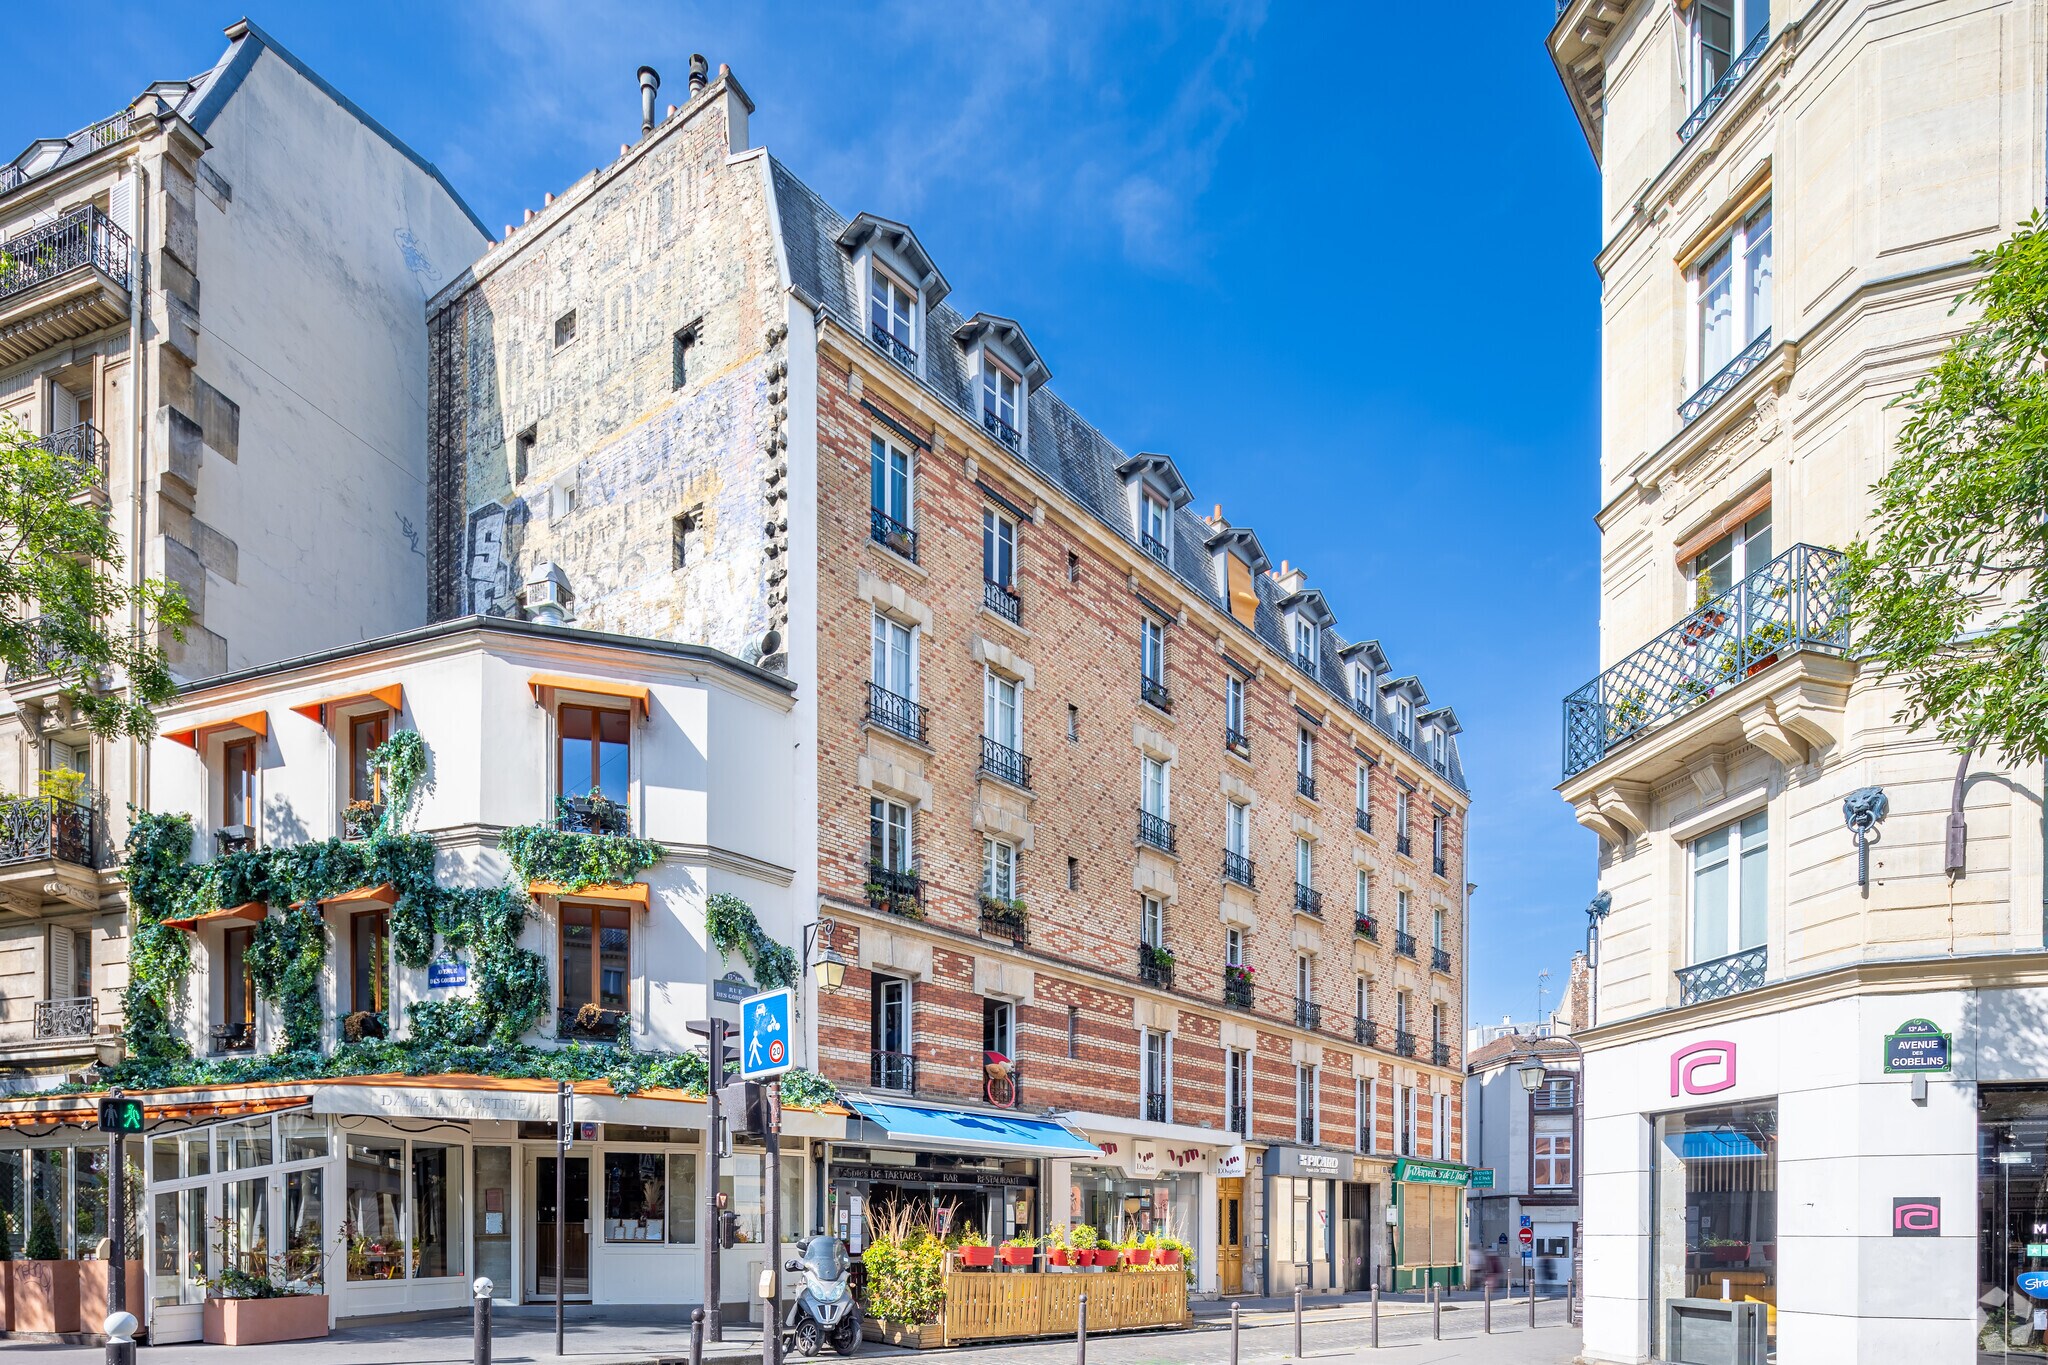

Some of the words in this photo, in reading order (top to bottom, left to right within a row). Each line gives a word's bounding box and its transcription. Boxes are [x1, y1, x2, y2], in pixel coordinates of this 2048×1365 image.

[1898, 1040, 1939, 1050] AVENUE
[772, 1047, 781, 1056] 20
[1891, 1056, 1944, 1067] GOBELINS
[381, 1094, 429, 1108] DAME
[435, 1096, 528, 1111] AUGUSTINE
[1307, 1154, 1339, 1168] PICARD
[870, 1169, 881, 1179] DE
[884, 1169, 923, 1181] TARTARES
[943, 1173, 959, 1183] BAR
[977, 1174, 1020, 1185] RESTAURANT
